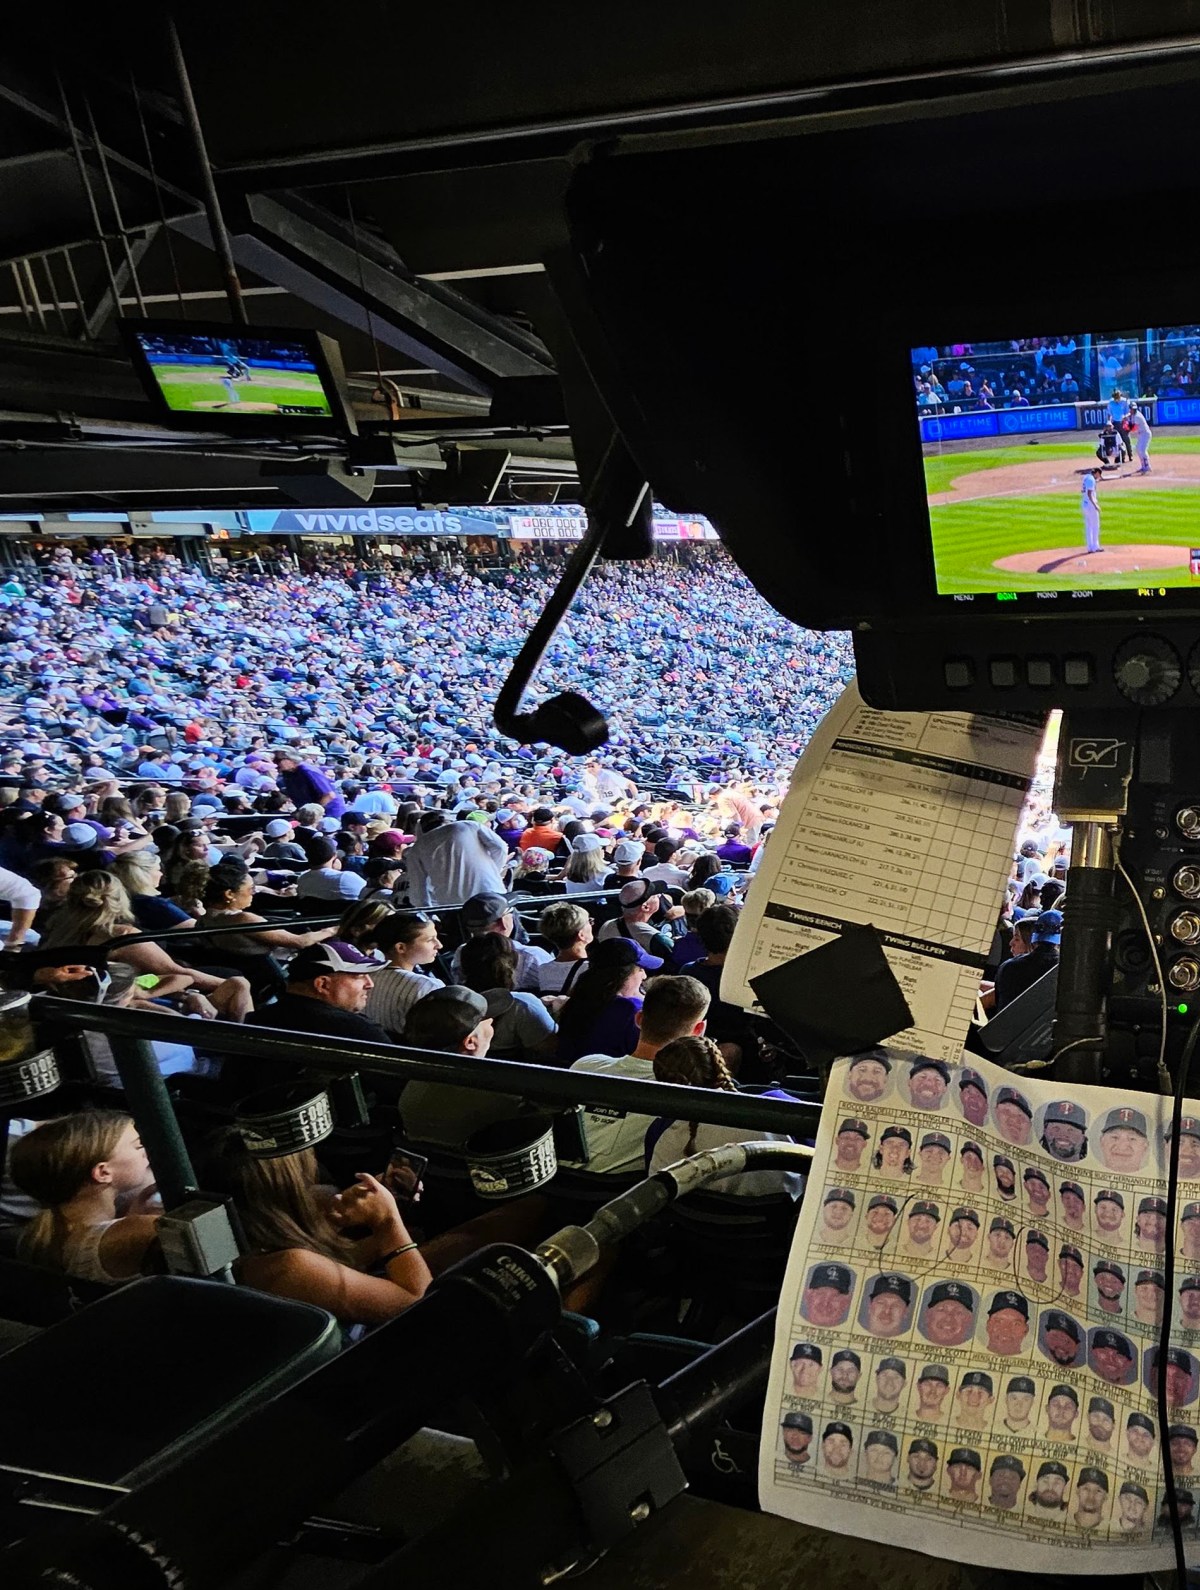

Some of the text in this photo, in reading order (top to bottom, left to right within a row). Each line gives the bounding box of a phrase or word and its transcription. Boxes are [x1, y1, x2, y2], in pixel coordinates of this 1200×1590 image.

[1019, 410, 1069, 425] LIFETIME
[295, 509, 462, 532] vividseats
[1071, 590, 1093, 598] ZOOM
[497, 1256, 537, 1290] Canon
[943, 1348, 968, 1358] SCOTT
